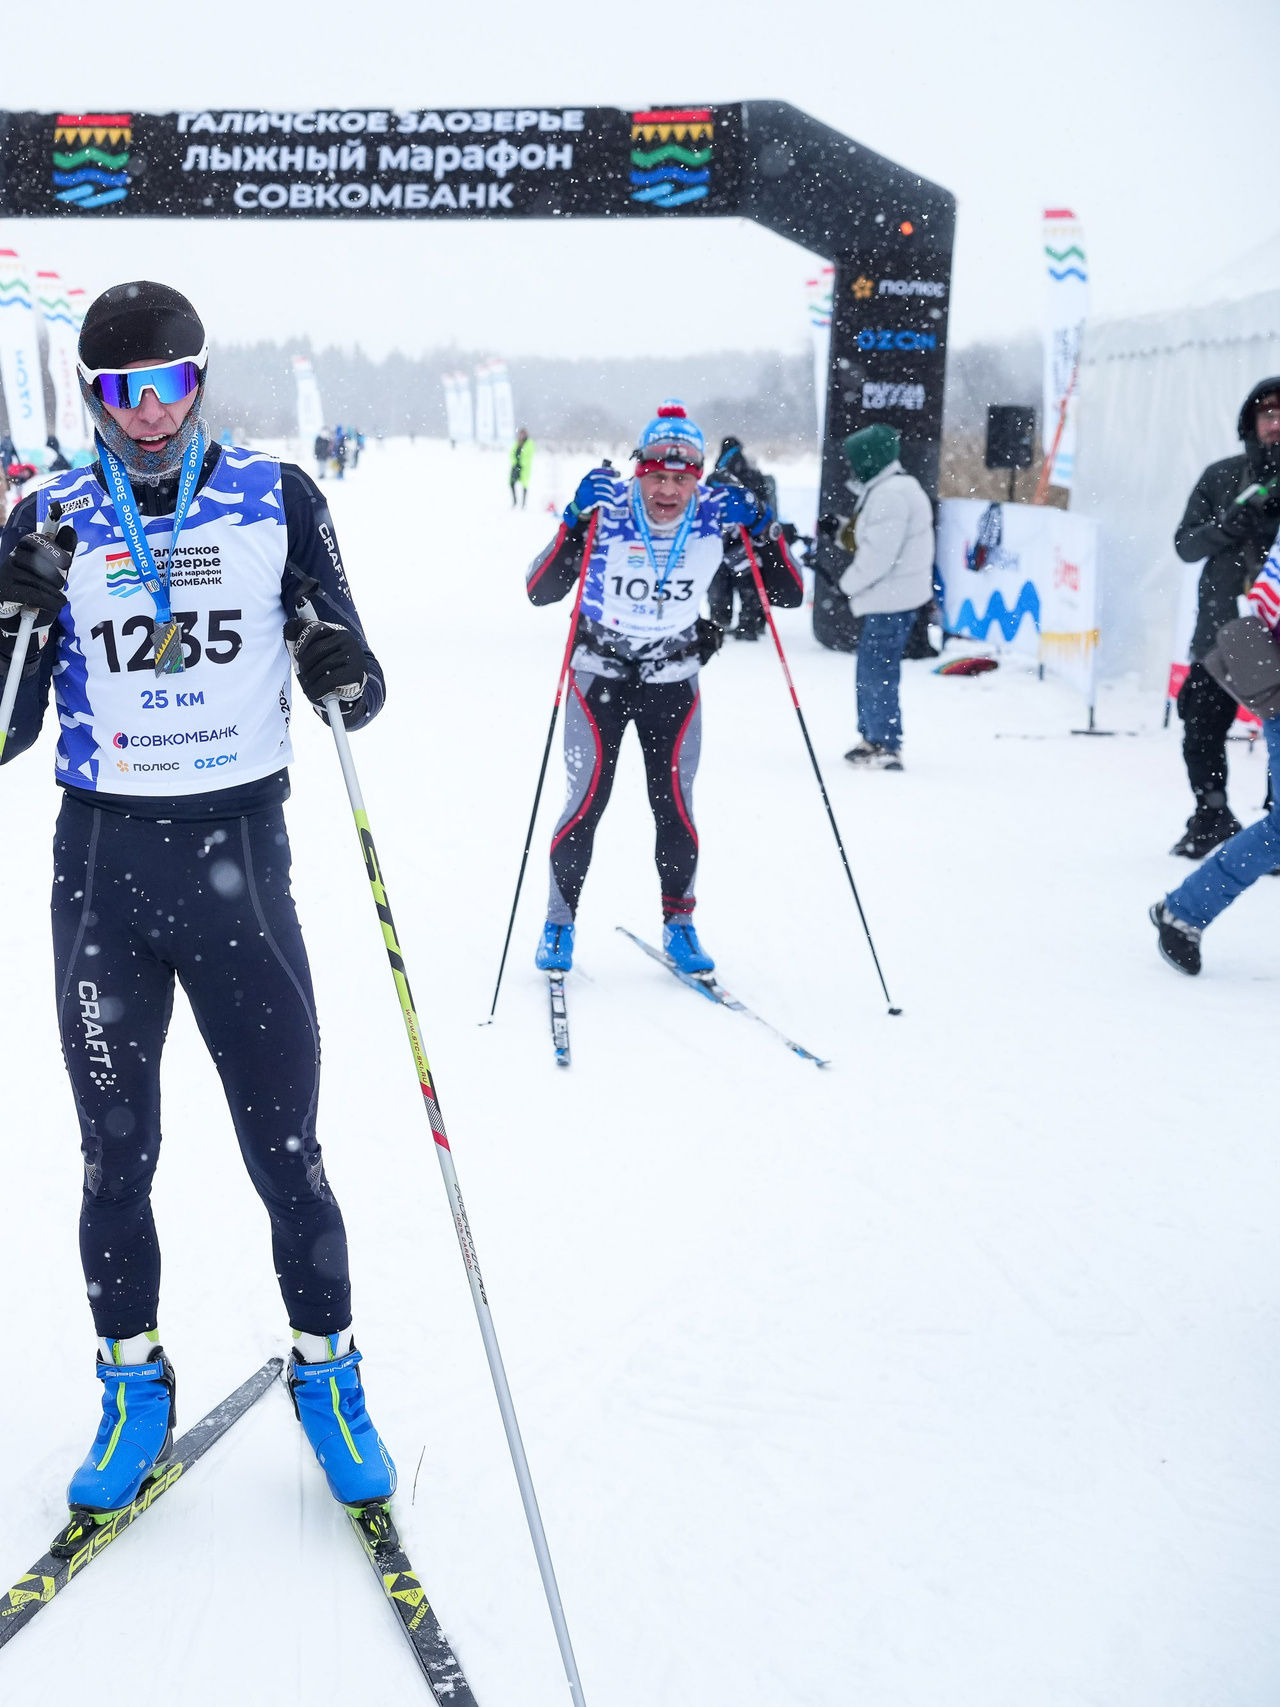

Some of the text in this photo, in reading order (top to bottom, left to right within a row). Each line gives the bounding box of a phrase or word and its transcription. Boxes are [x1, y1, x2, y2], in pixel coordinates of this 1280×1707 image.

[177, 110, 585, 134] ГАЛИЧСКОЕ ЗАОЗЕРЬЕ
[378, 139, 574, 180] марафон
[233, 182, 515, 209] СОВКОМБАНК
[856, 329, 937, 350] OZON
[104, 447, 150, 576] Галичское Заозерь
[149, 545, 220, 558] аличское
[154, 557, 221, 569] аозерье
[318, 522, 346, 583] CRAFT
[169, 577, 222, 587] КОМБАНК
[184, 568, 222, 577] марафон
[610, 576, 695, 601] 1053
[631, 604, 646, 614] 25
[90, 609, 243, 673] 1235
[140, 690, 169, 709] 25
[130, 724, 239, 747] СОВКОМБАНК
[194, 752, 238, 769] OZON
[78, 980, 113, 1069] CRAFT
[405, 1008, 428, 1084] WWW.STC-SKI.RU
[456, 1213, 473, 1270] 100% CARBON
[105, 1368, 157, 1378] SPINE
[303, 1360, 354, 1377] SPINE
